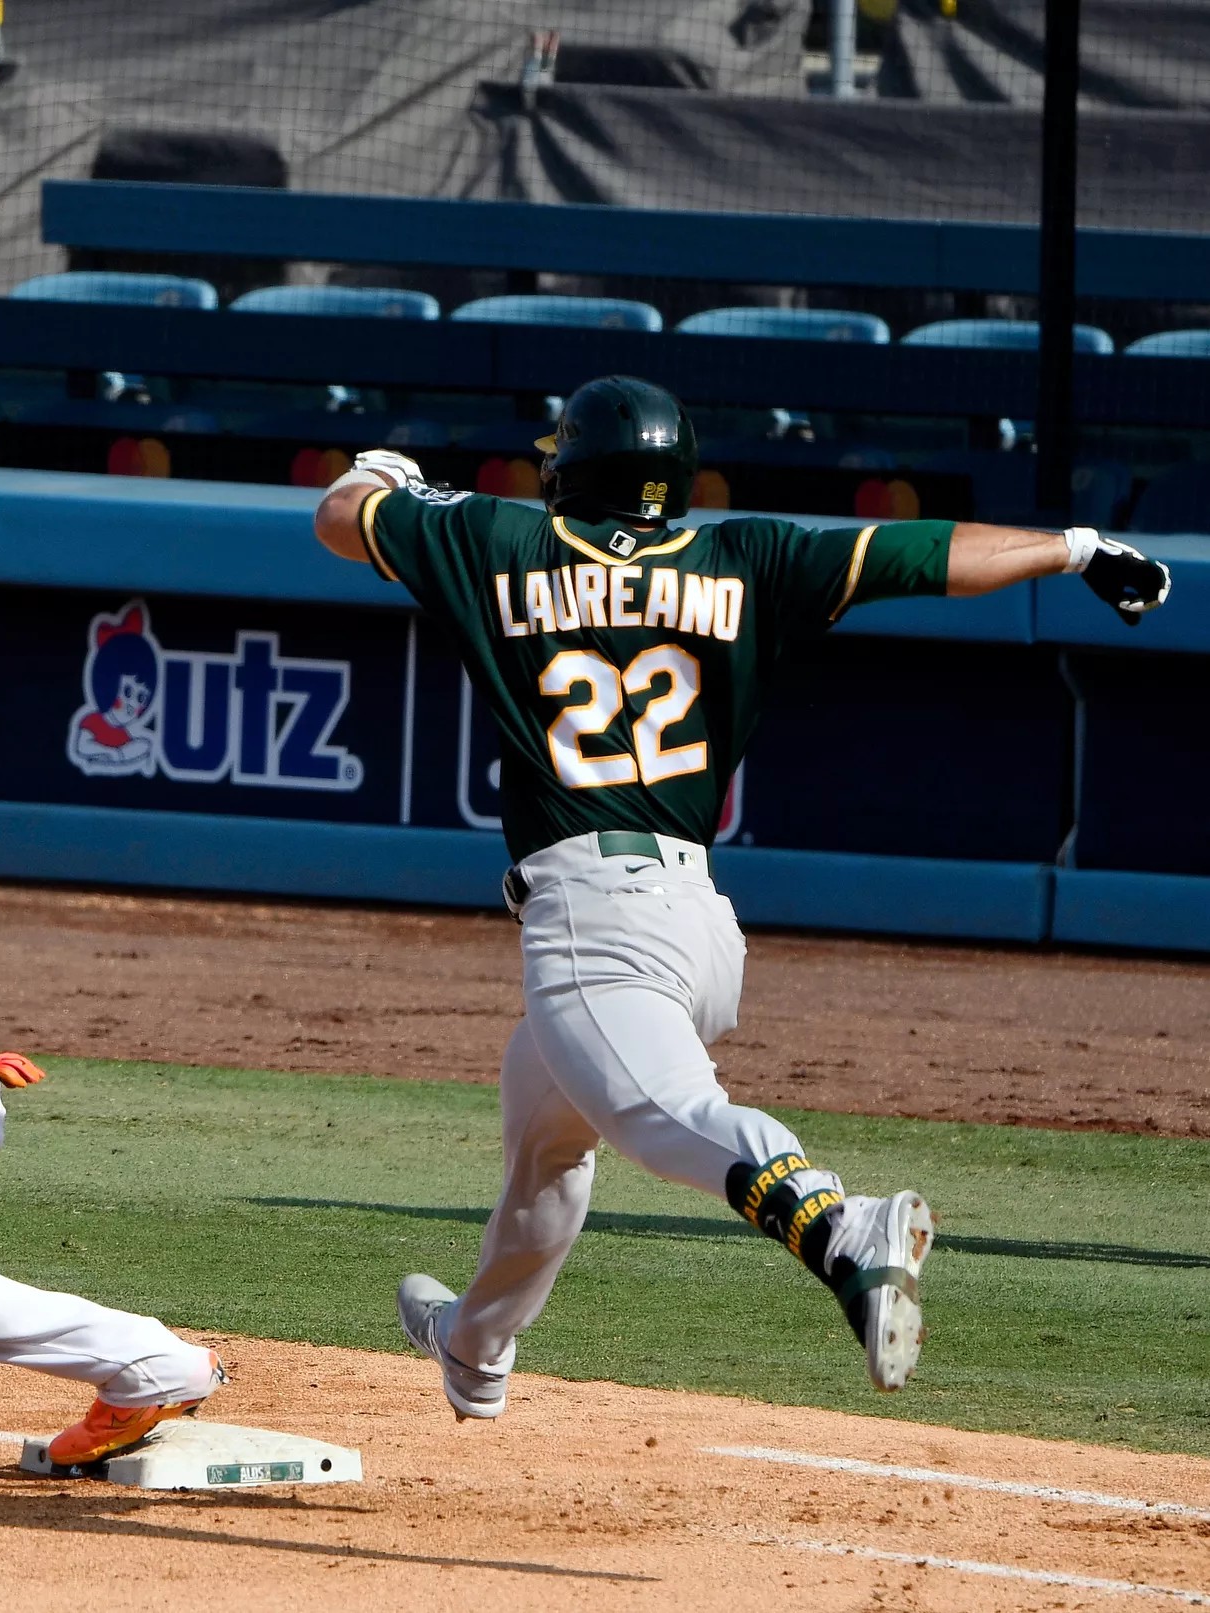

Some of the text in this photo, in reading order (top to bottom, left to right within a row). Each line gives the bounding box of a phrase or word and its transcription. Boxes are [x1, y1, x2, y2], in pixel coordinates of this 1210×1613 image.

[641, 481, 668, 501] 22
[495, 563, 744, 642] LAUREANO
[538, 643, 707, 788] 22
